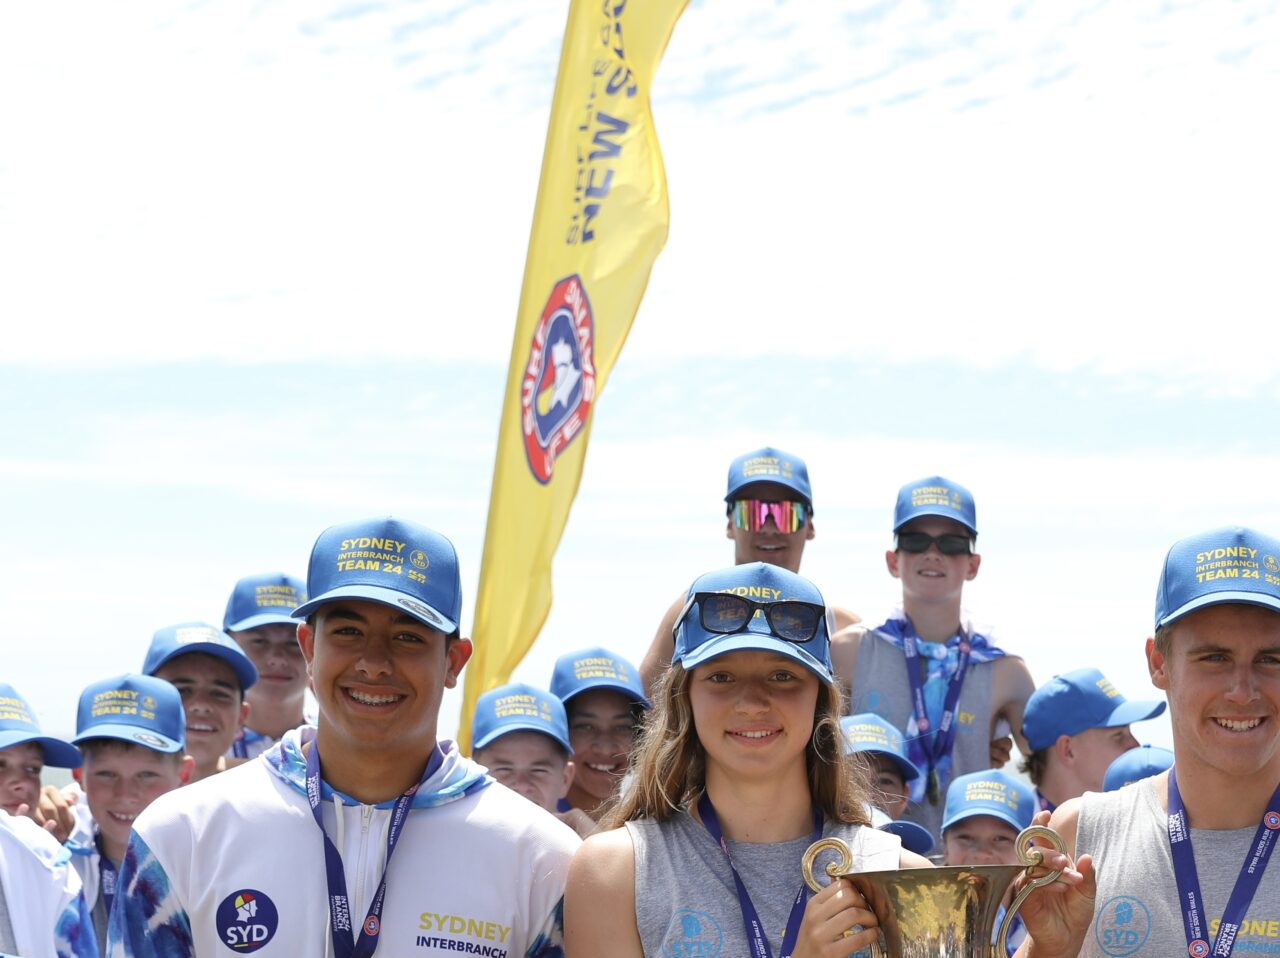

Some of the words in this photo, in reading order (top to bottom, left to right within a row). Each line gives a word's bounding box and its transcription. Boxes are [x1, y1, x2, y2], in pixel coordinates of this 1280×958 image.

[341, 537, 406, 553] SYDNEY
[338, 551, 404, 564] INTERBRANCH
[1196, 546, 1258, 563] SYDNEY
[337, 560, 380, 572] TEAM
[383, 563, 402, 575] 24
[1195, 560, 1259, 573] INTERBRANCH
[1196, 568, 1239, 583] TEAM
[1242, 569, 1260, 580] 24
[574, 658, 614, 667] SYDNEY
[576, 671, 604, 679] TEAM
[94, 690, 139, 703] SYDNEY
[495, 695, 537, 706] SYDNEY
[92, 706, 120, 718] TEAM
[122, 706, 137, 715] 24
[496, 708, 524, 718] TEAM
[525, 709, 538, 717] 24
[967, 781, 1006, 791] SYDNEY
[966, 793, 992, 801] TEAM
[1174, 813, 1184, 843] BRANCH
[1262, 829, 1271, 840] NEW
[1255, 839, 1266, 858] SOUTH
[1247, 857, 1259, 874] WALES
[1188, 891, 1197, 910] WALES
[334, 895, 345, 930] BRANCH
[341, 895, 351, 931] INTER24
[226, 924, 269, 945] SYD
[418, 912, 512, 943] SYDNEY
[751, 920, 762, 939] WALES
[1103, 928, 1139, 945] SYD
[1217, 922, 1232, 954] BRANCH
[757, 938, 768, 956] SOUTH
